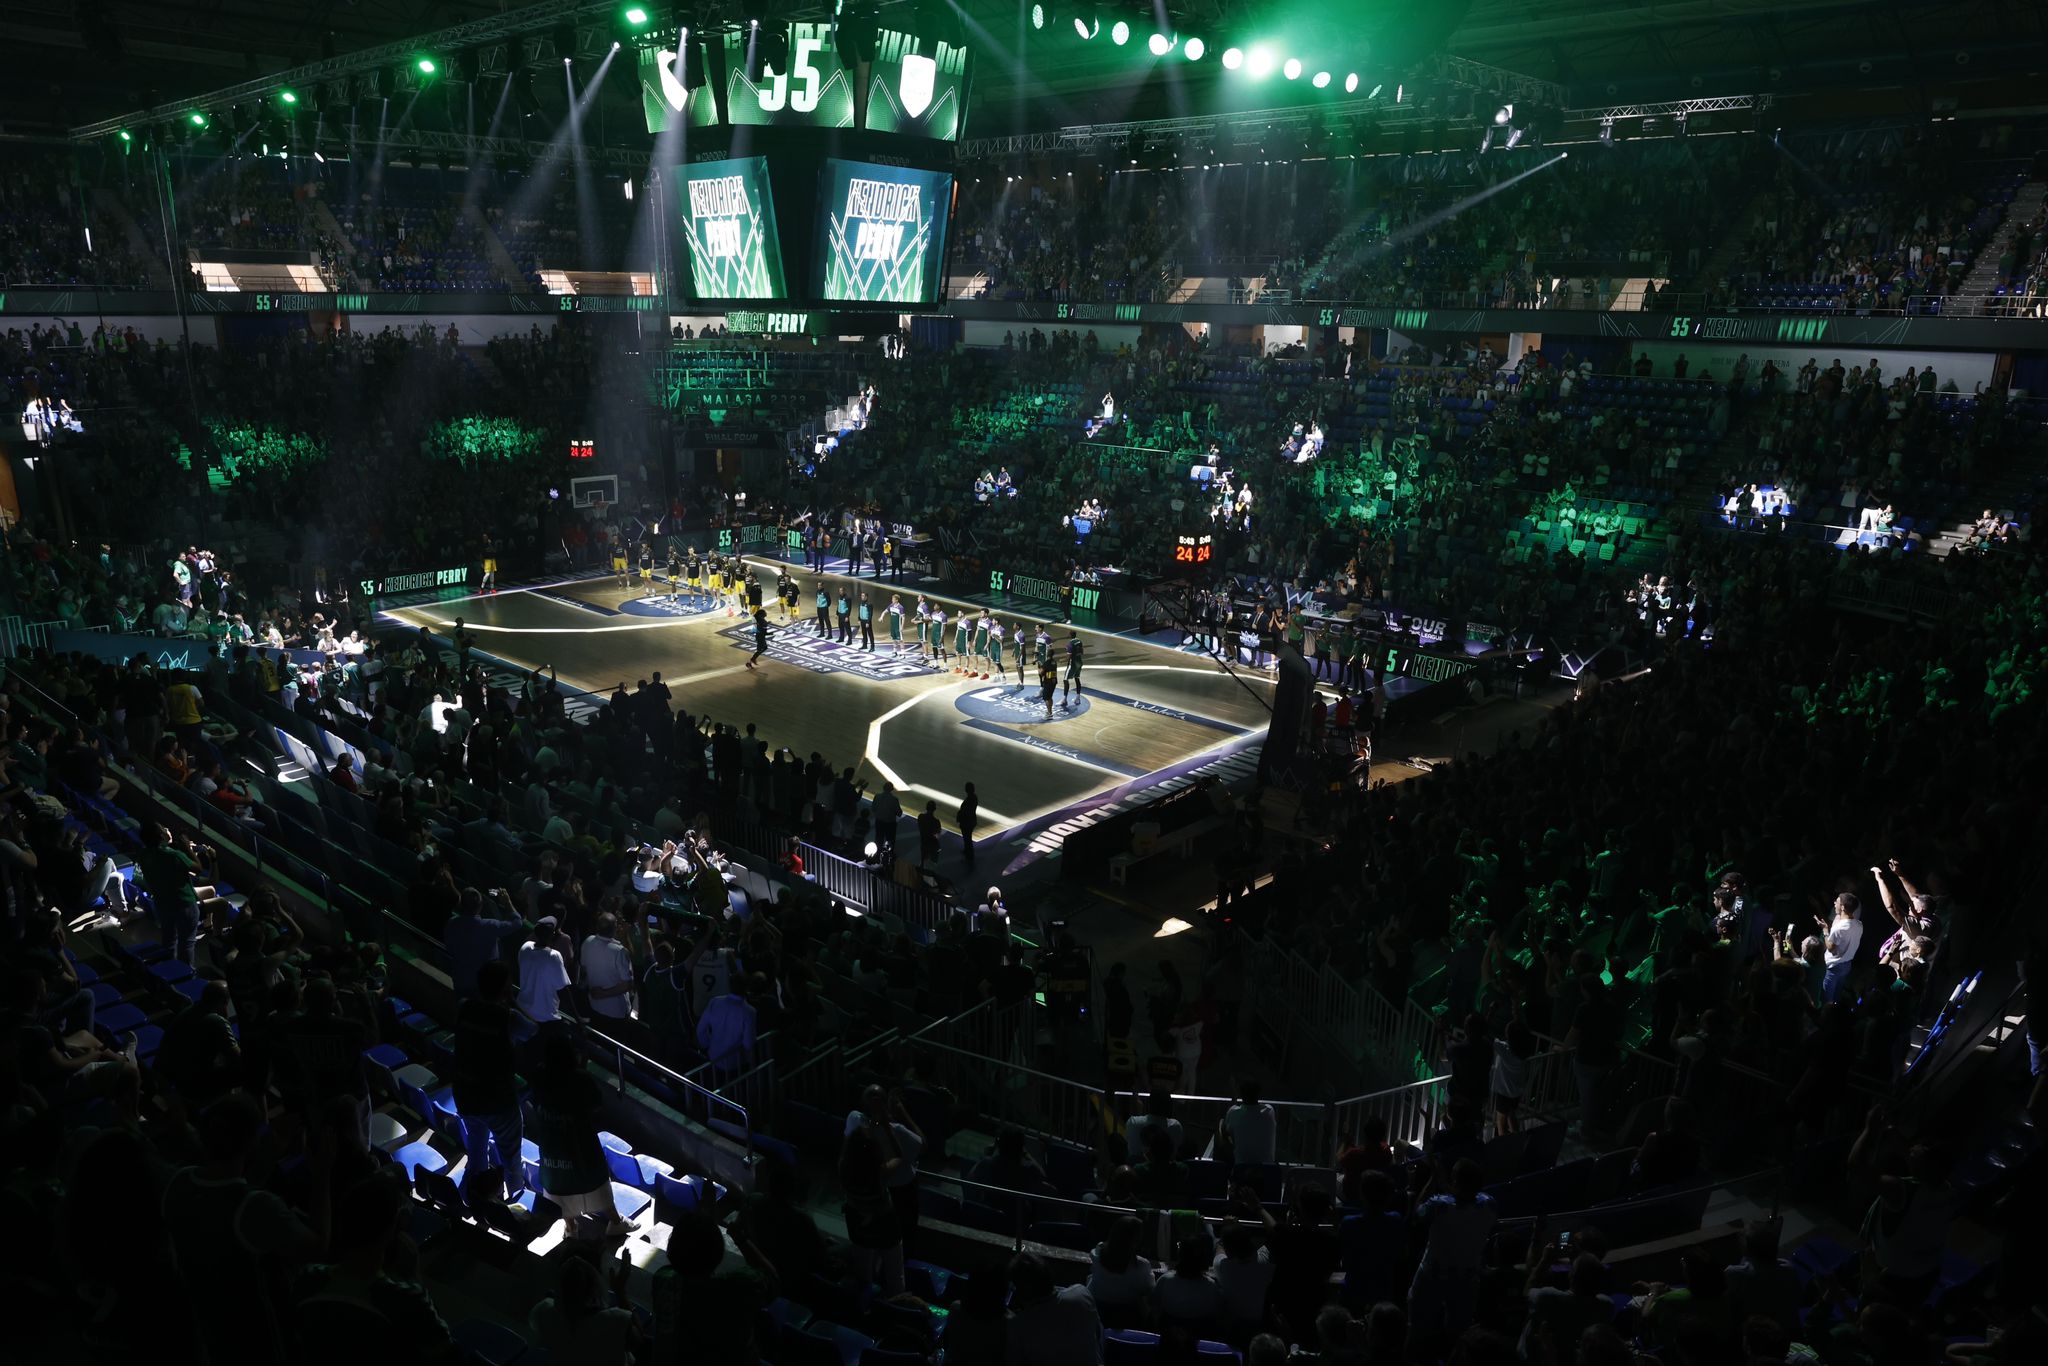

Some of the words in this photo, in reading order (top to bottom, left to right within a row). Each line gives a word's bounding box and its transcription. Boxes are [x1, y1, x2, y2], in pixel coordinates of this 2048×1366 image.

[935, 40, 967, 76] OUR
[688, 175, 747, 218] KENDRICK
[848, 178, 922, 222] KENDRICK
[705, 221, 743, 257] PERRY
[854, 221, 905, 260] PERRY
[256, 294, 271, 311] 55
[560, 296, 573, 311] 55
[1057, 303, 1069, 319] 55
[767, 313, 808, 333] PERRY
[1319, 309, 1333, 326] 55
[1671, 316, 1691, 337] 55
[580, 447, 593, 457] 24
[718, 529, 732, 547] 55
[892, 523, 913, 536] OUR
[1176, 546, 1194, 562] 24
[1197, 545, 1210, 562] 24
[384, 571, 435, 592] KENDRICK
[437, 567, 468, 585] PERRY
[990, 570, 1004, 591] 55
[1012, 574, 1062, 603] KENDRICK
[1071, 586, 1100, 611] ERRY
[819, 647, 923, 676] FOUR
[703, 973, 717, 992] 9
